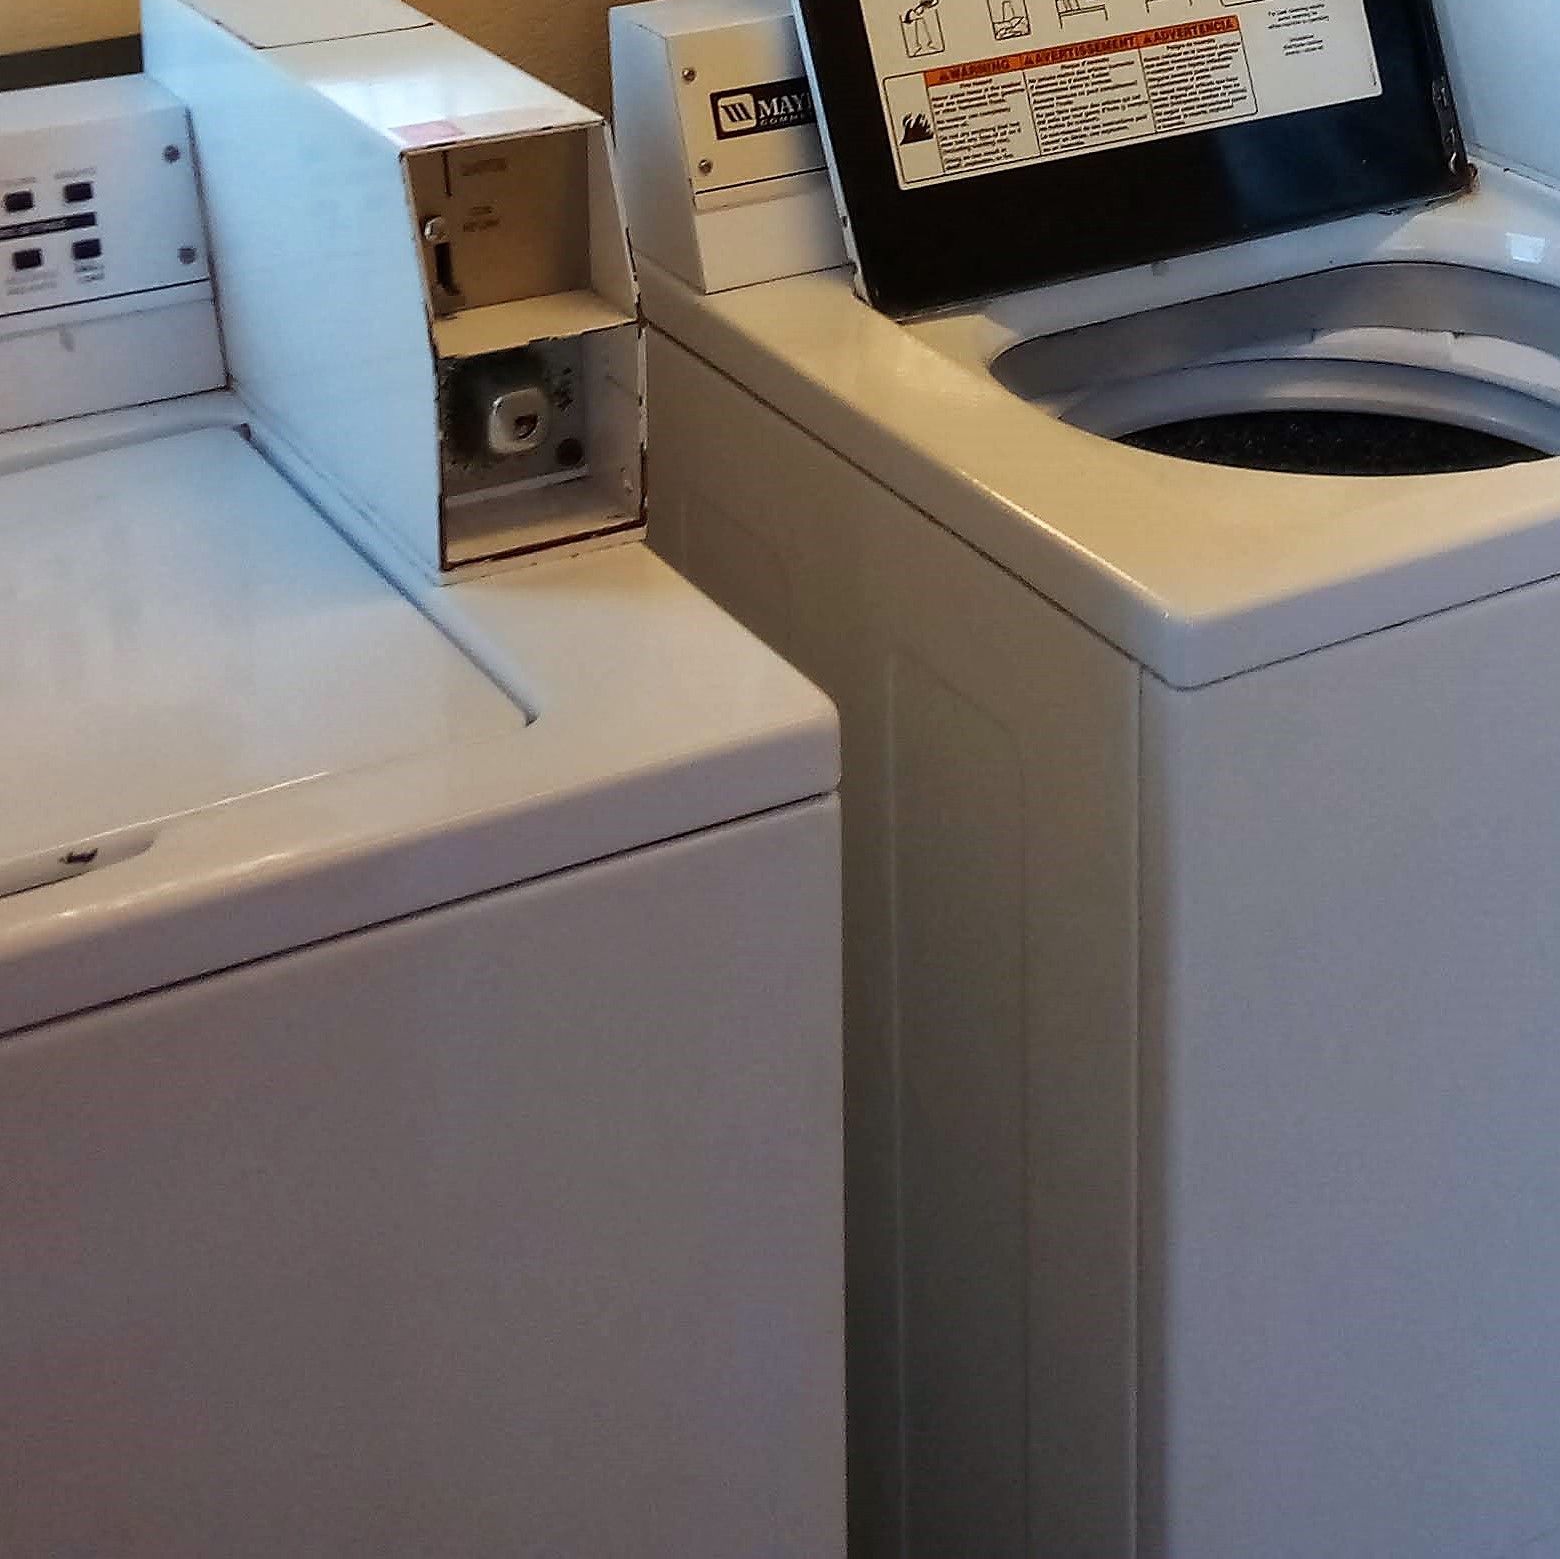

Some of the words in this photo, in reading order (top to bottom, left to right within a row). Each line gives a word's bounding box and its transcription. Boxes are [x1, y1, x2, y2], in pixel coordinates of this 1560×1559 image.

[1154, 19, 1235, 40] ADVERTENCIA
[1035, 36, 1136, 61] AVERTISSEMENT
[948, 58, 1011, 77] WARNING
